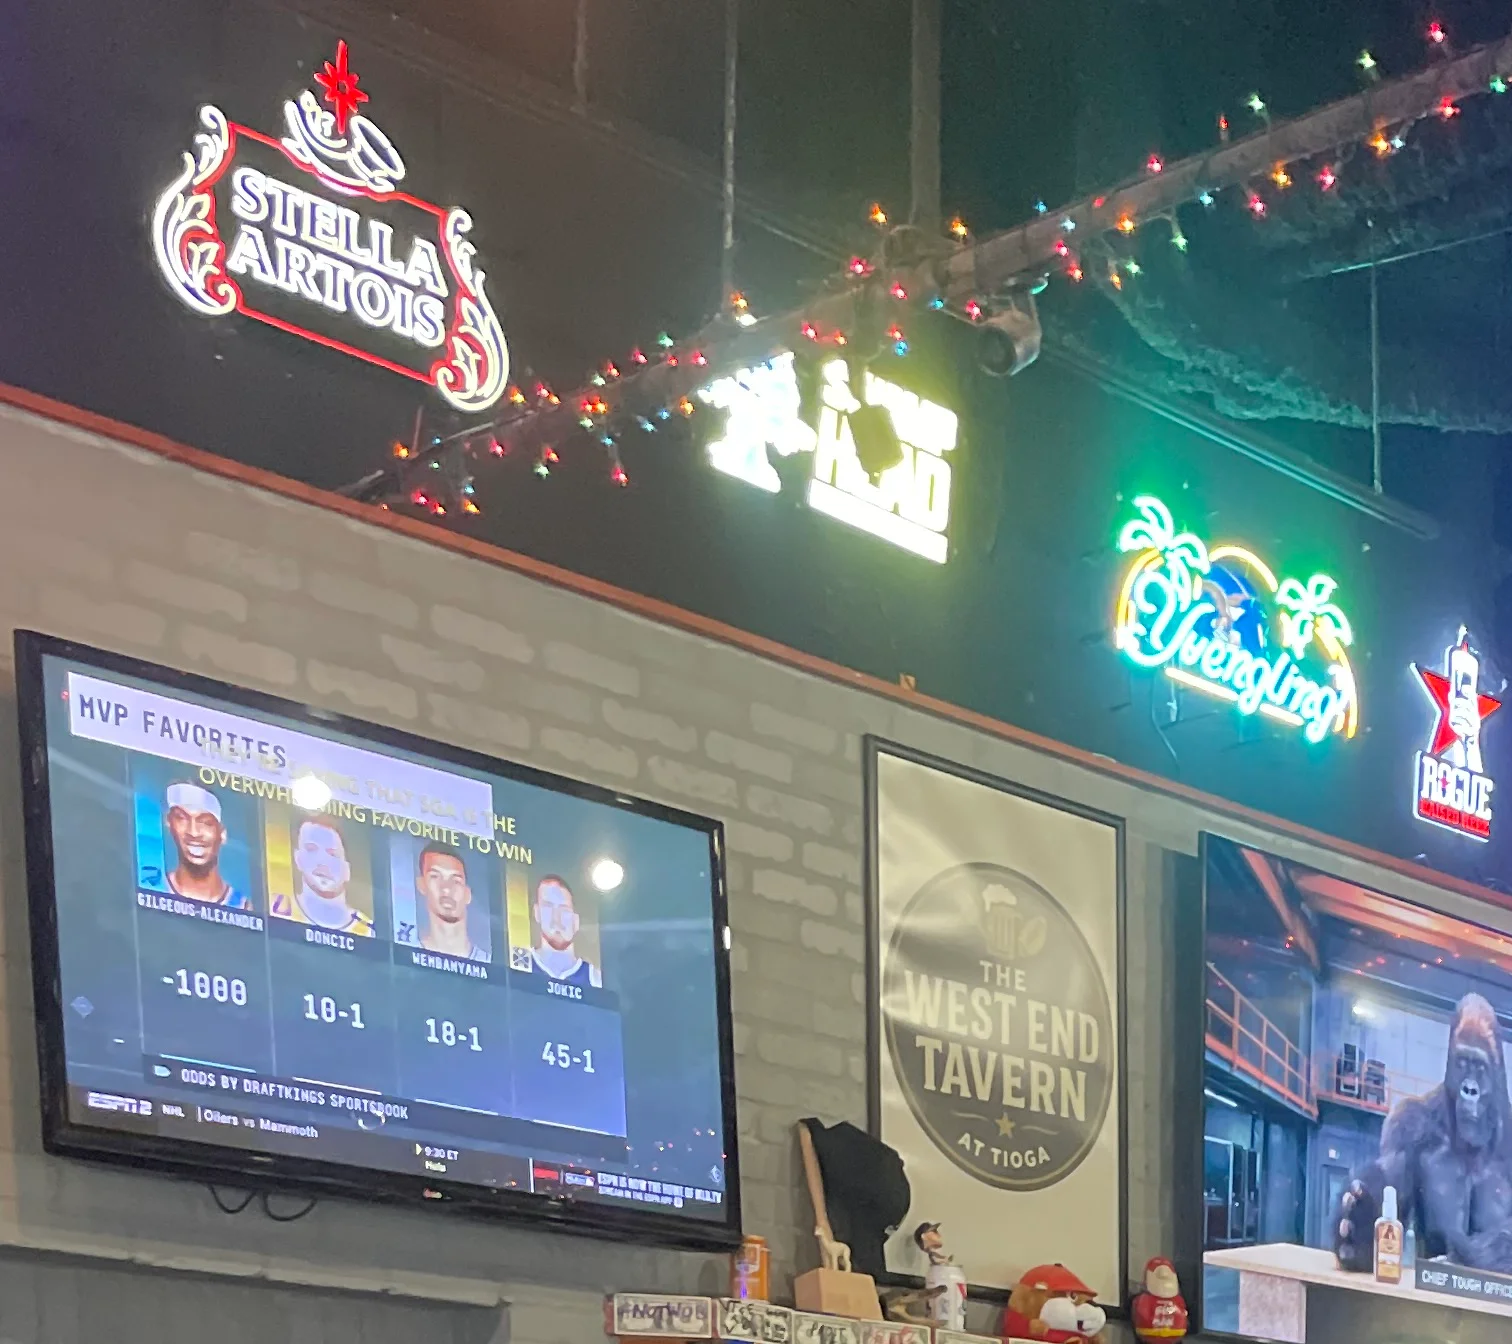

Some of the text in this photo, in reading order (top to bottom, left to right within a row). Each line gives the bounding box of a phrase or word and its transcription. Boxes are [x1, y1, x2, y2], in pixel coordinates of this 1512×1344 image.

[231, 167, 449, 297] STELLA
[228, 225, 446, 348] ARTOIS
[78, 694, 287, 768] MVP FAVORITES
[1420, 755, 1494, 821] ROGUE
[373, 811, 461, 847] FAVORITE
[468, 833, 491, 854] TO
[495, 838, 533, 866] WIN
[481, 810, 517, 836] THE
[136, 893, 265, 932] GILGEOUS-ALEXANDER
[305, 928, 355, 952] DONCIC
[412, 951, 488, 980] WEMBANYAMA
[979, 960, 1028, 993] THE
[161, 968, 248, 1007] -1000
[303, 993, 365, 1030] 10-1
[904, 969, 1100, 1065] WEST END
[425, 1017, 483, 1052] 18-1
[541, 1041, 595, 1074] 45-1
[181, 1067, 409, 1120] ODDS BY DRAFTKINGS SPORTSBOOK
[915, 1035, 1088, 1122] TAVERN
[957, 1131, 1051, 1170] AT TIOGA
[1421, 1270, 1449, 1287] CHIEF
[1451, 1275, 1481, 1293] TOUGH
